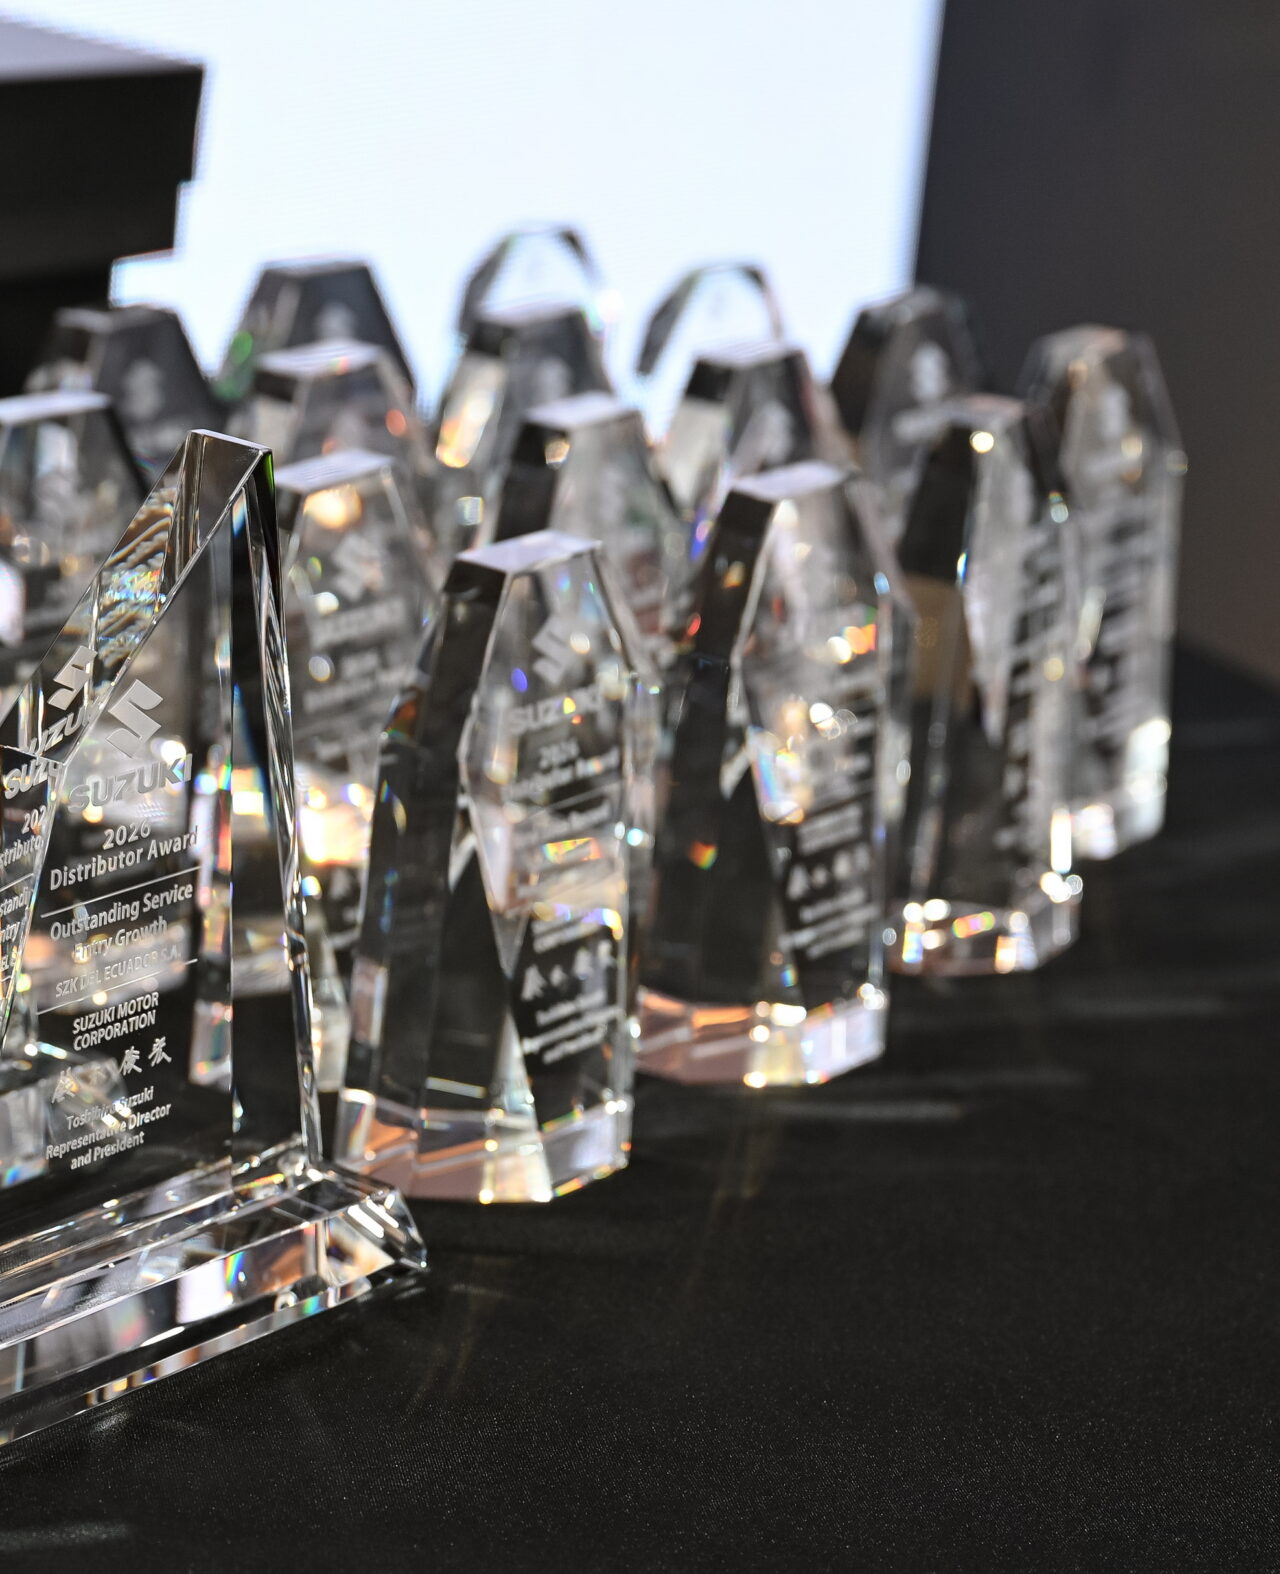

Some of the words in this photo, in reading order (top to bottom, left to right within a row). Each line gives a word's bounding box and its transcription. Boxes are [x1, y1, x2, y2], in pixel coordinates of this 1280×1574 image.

[68, 753, 192, 812] SUZUKI
[102, 819, 151, 850] 2026
[50, 849, 143, 891] Distributor
[147, 826, 199, 860] Award
[50, 901, 140, 940] Outstanding
[143, 883, 193, 912] Service
[74, 935, 112, 959] Entry
[115, 916, 167, 946] Growth
[55, 976, 80, 998] SZK
[105, 951, 158, 980] ECUADOR
[72, 1007, 115, 1035] SUZUKI
[117, 992, 159, 1019] MOTOR
[73, 1010, 156, 1051] CORPORATION
[129, 1104, 171, 1130] Director
[70, 1150, 91, 1170] and
[93, 1131, 145, 1162] President
